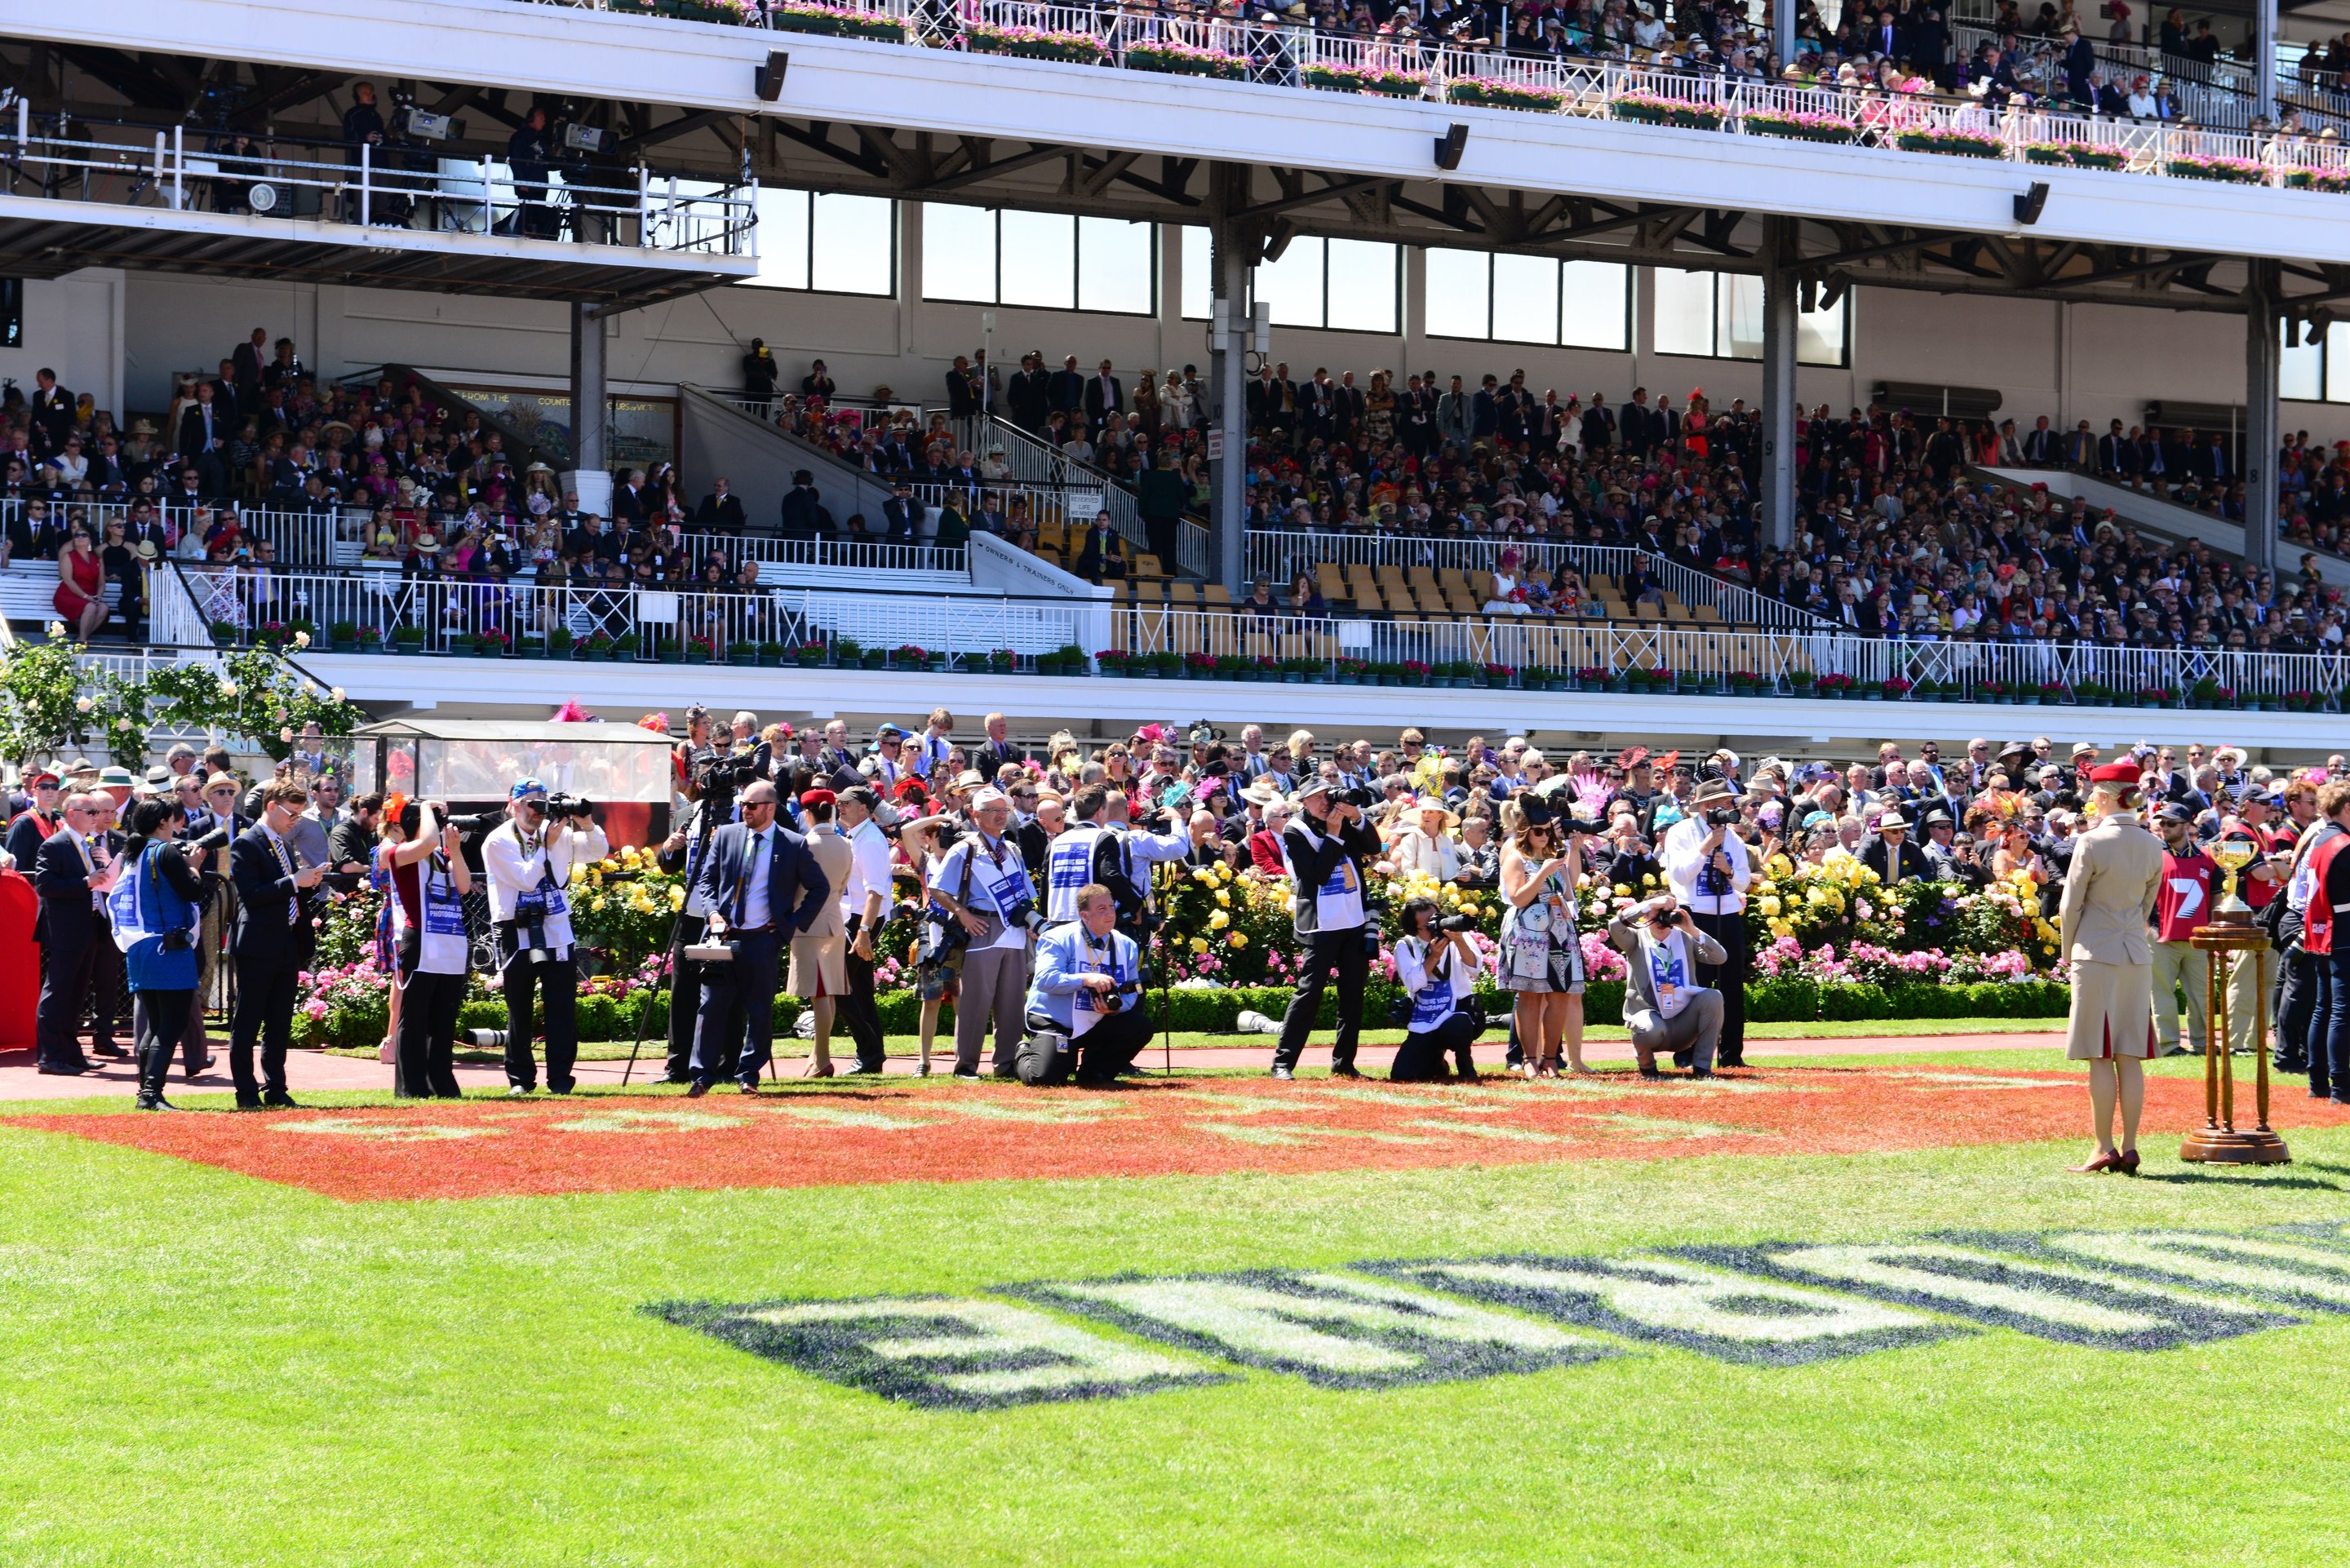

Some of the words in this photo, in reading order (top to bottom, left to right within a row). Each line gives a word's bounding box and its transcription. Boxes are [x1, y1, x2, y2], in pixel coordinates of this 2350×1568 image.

[461, 392, 490, 401] FROM
[492, 393, 510, 403] THE
[606, 401, 630, 411] CUBS
[1766, 441, 1773, 456] 9
[2250, 468, 2258, 484] 8
[985, 546, 1013, 565] OWNERS
[1023, 565, 1055, 586] TRAINERS
[1057, 582, 1075, 595] ONLY
[963, 863, 971, 881] Canon
[2167, 878, 2205, 919] 7
[267, 1070, 2086, 1141] Emirates
[1187, 1112, 1775, 1145] Fly
